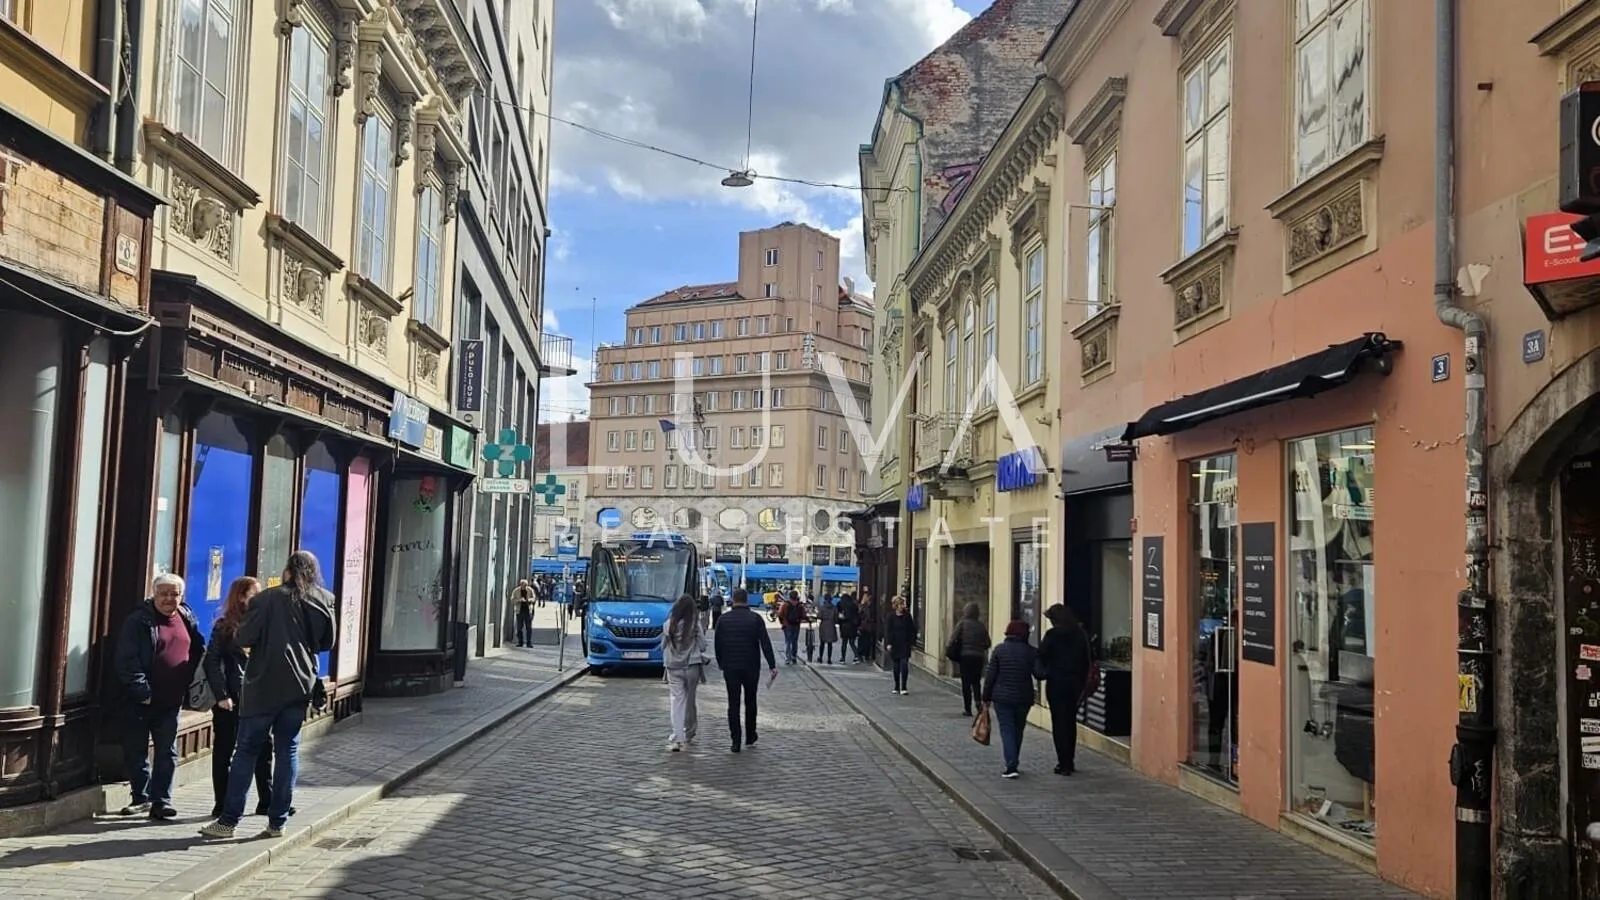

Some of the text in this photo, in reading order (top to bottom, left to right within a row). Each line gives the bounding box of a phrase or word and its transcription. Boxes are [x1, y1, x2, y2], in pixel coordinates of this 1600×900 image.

[1543, 256, 1582, 268] E-Scoote
[1527, 340, 1540, 354] 3A
[1438, 361, 1444, 373] 3
